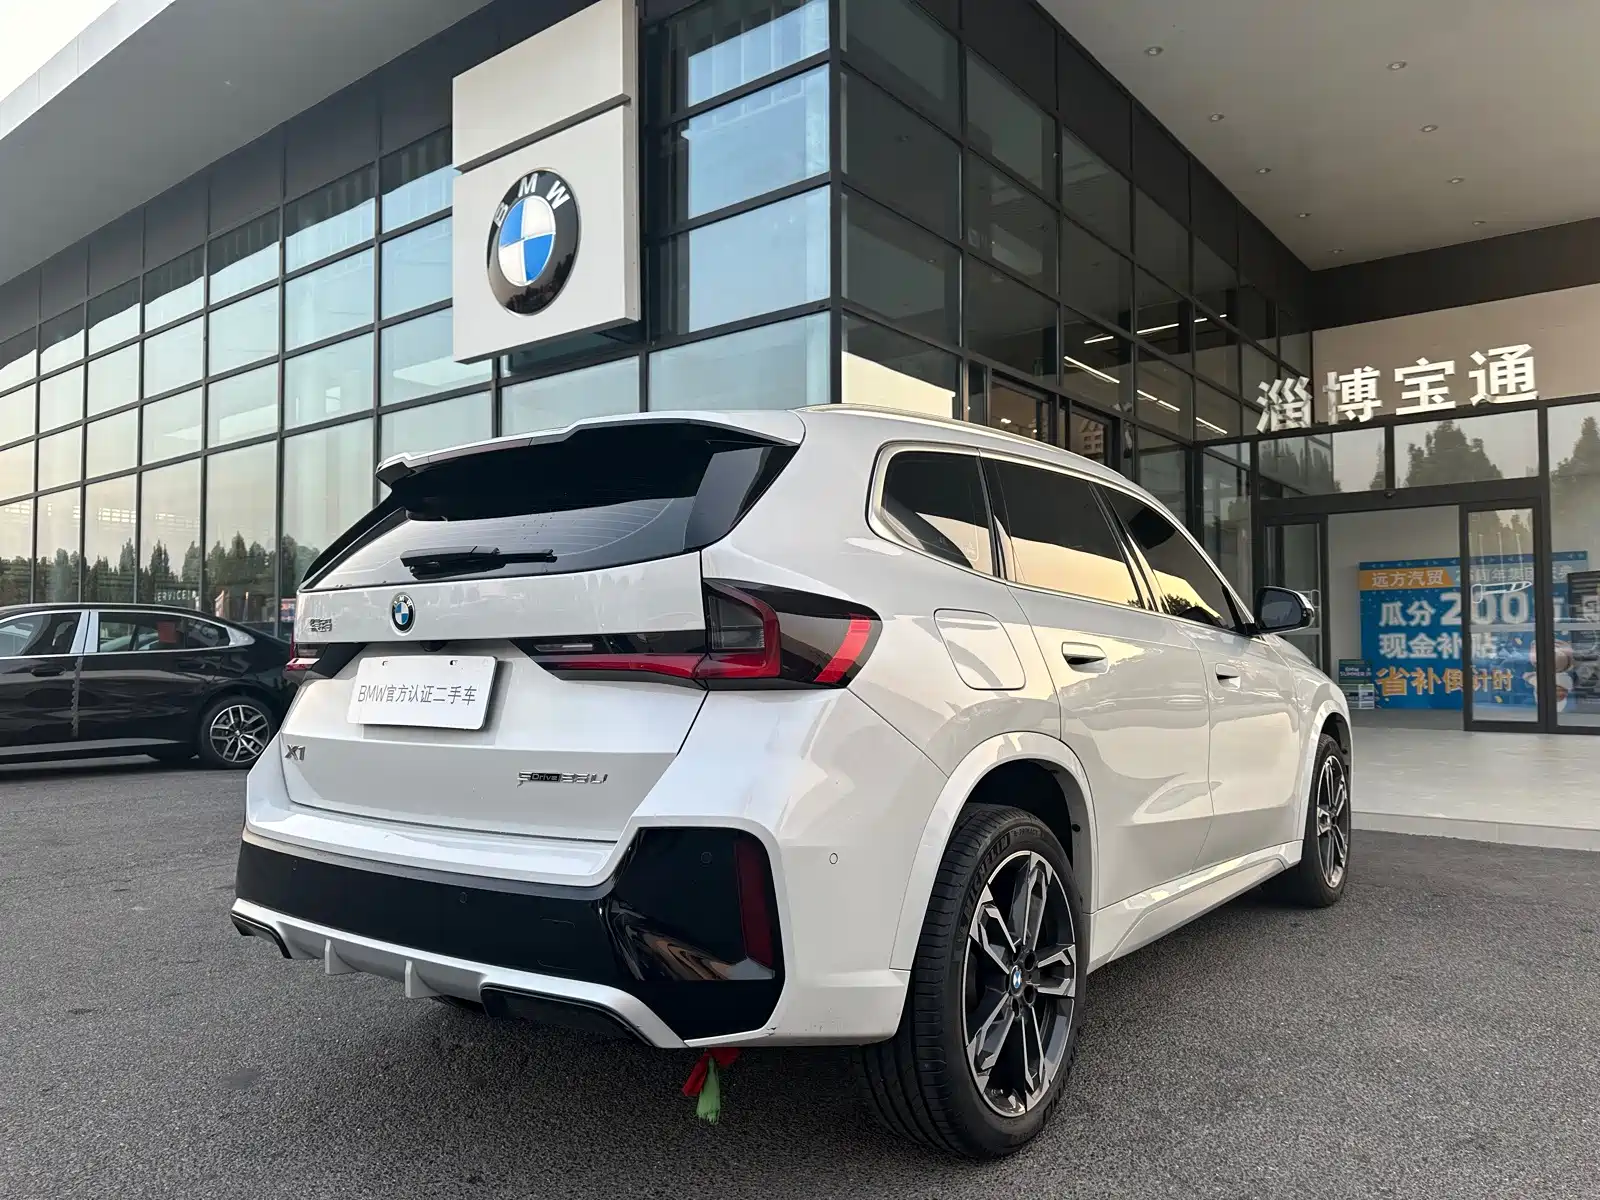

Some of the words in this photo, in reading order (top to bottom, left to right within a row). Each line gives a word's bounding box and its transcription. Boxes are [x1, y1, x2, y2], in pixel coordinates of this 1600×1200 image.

[493, 173, 571, 228] BMW
[1256, 344, 1540, 433] 淄博宝通
[1371, 569, 1444, 588] 远方汽贸
[357, 684, 477, 706] BMW官方认证二手车
[284, 744, 306, 761] X1
